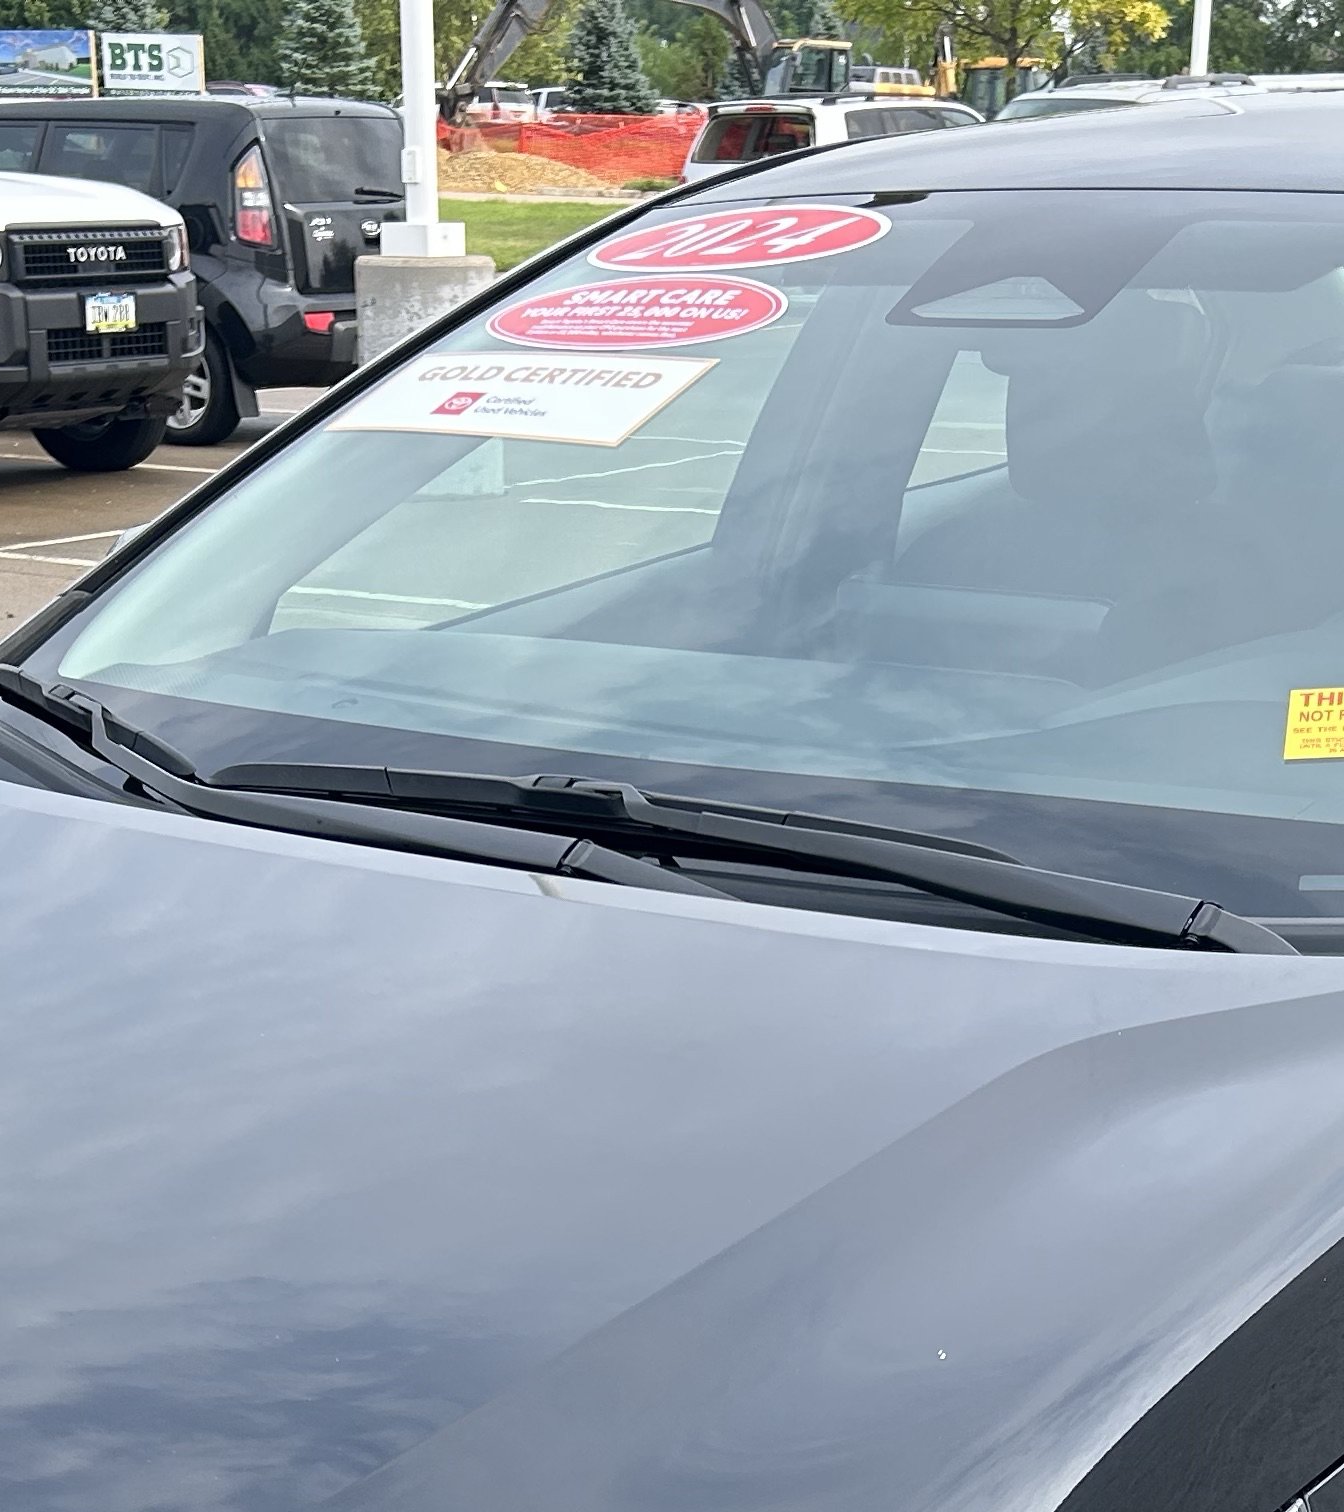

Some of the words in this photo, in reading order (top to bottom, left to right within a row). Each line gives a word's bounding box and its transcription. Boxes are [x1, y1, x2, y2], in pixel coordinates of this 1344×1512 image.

[108, 42, 163, 71] BTS
[613, 217, 839, 262] 2024
[67, 246, 126, 262] TOYOTA
[563, 290, 663, 305] SMART
[660, 289, 741, 305] CARE
[521, 307, 573, 318] YOUR
[568, 306, 620, 318] FIRST
[680, 307, 713, 318] ON
[711, 308, 749, 320] US!
[418, 365, 505, 382] GOLD
[504, 367, 663, 389] CERTIFIED
[486, 395, 535, 405] Certified
[474, 406, 502, 414] Used
[505, 406, 547, 417] Vehicles
[1299, 709, 1334, 722] NOT
